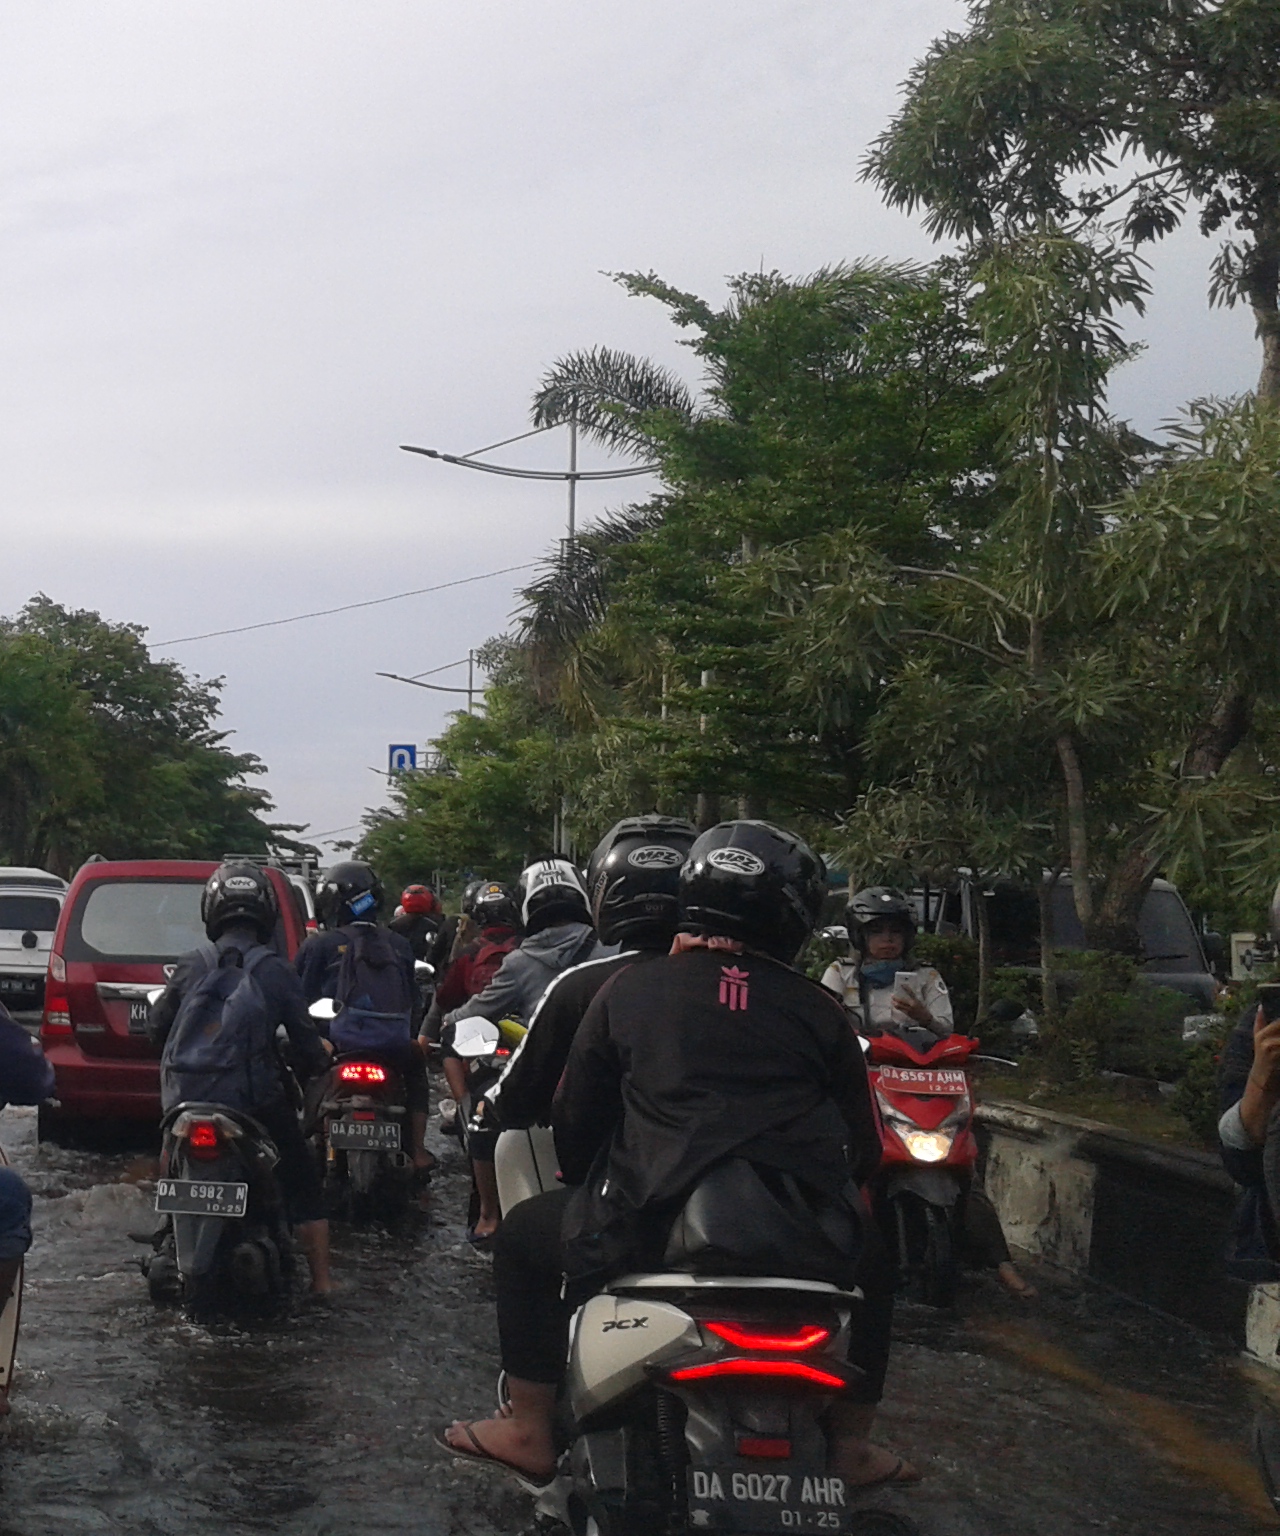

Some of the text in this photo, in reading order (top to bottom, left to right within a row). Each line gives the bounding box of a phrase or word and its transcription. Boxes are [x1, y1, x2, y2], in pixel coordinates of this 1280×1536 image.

[229, 877, 253, 887] NHK
[131, 1004, 147, 1020] KH
[883, 1067, 899, 1079] DA
[901, 1070, 933, 1082] 6567
[331, 1122, 346, 1135] DA
[159, 1182, 245, 1200] DA 6982 N
[693, 1470, 846, 1507] DA 6027 AHR
